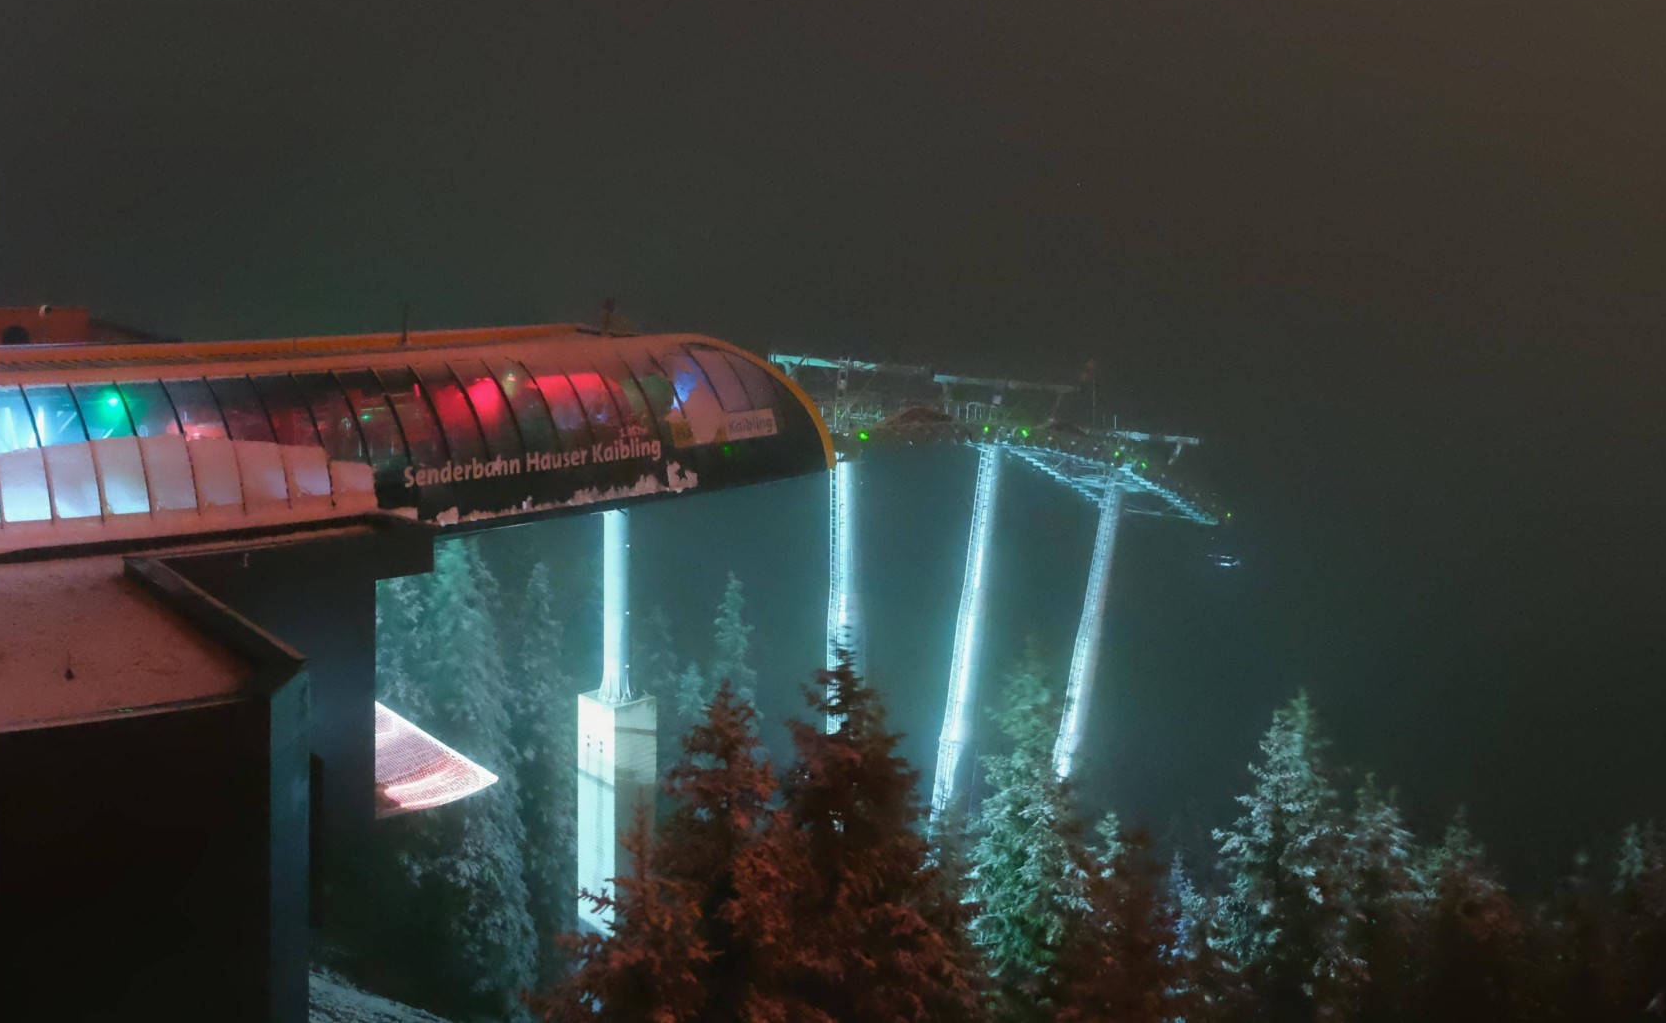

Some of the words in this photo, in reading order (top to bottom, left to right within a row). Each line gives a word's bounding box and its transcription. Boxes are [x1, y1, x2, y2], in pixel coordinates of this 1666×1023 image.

[403, 455, 521, 489] Senderbahn
[525, 446, 589, 473] Hauser
[592, 436, 662, 463] Kaibling
